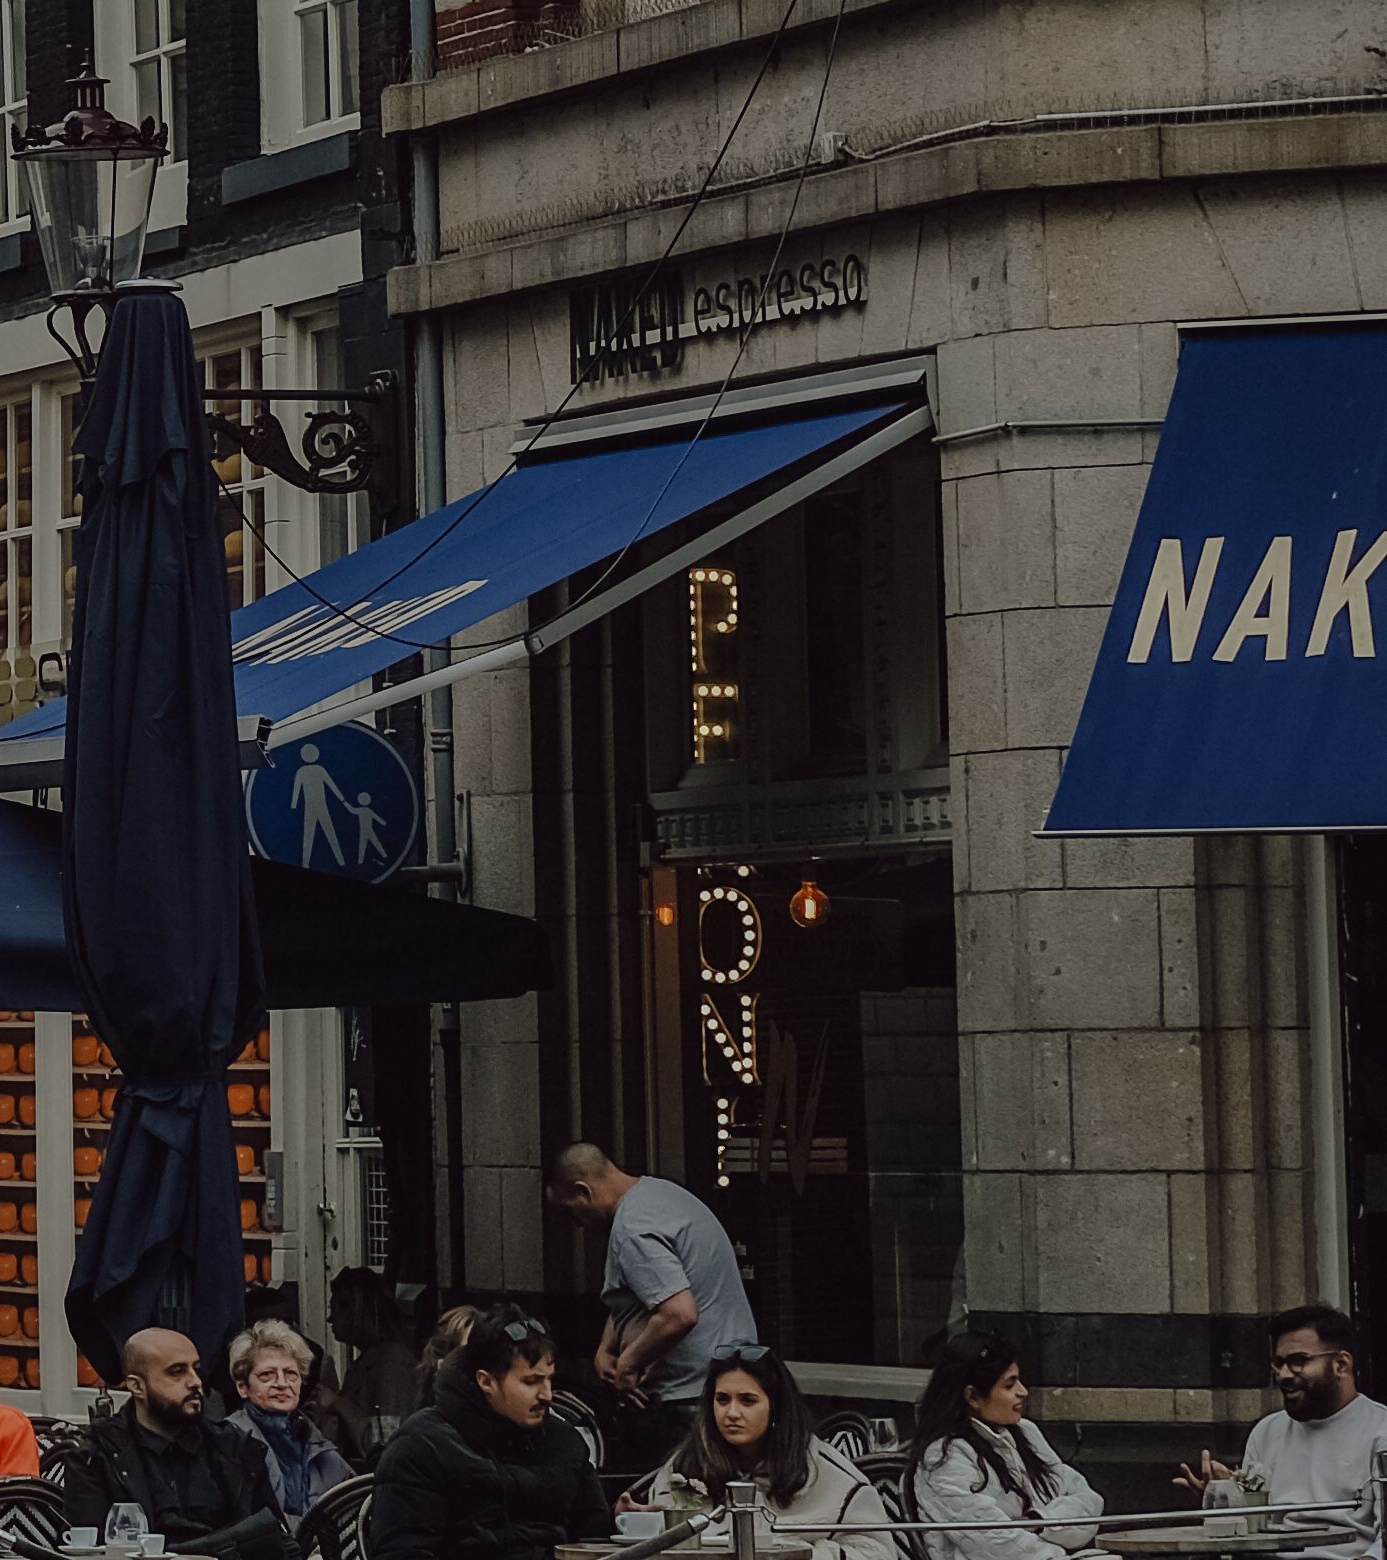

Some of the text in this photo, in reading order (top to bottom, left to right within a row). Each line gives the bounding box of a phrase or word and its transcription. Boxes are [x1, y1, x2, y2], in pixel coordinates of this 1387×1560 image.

[570, 253, 864, 385] NAKED espresso
[1126, 528, 1387, 665] NAK
